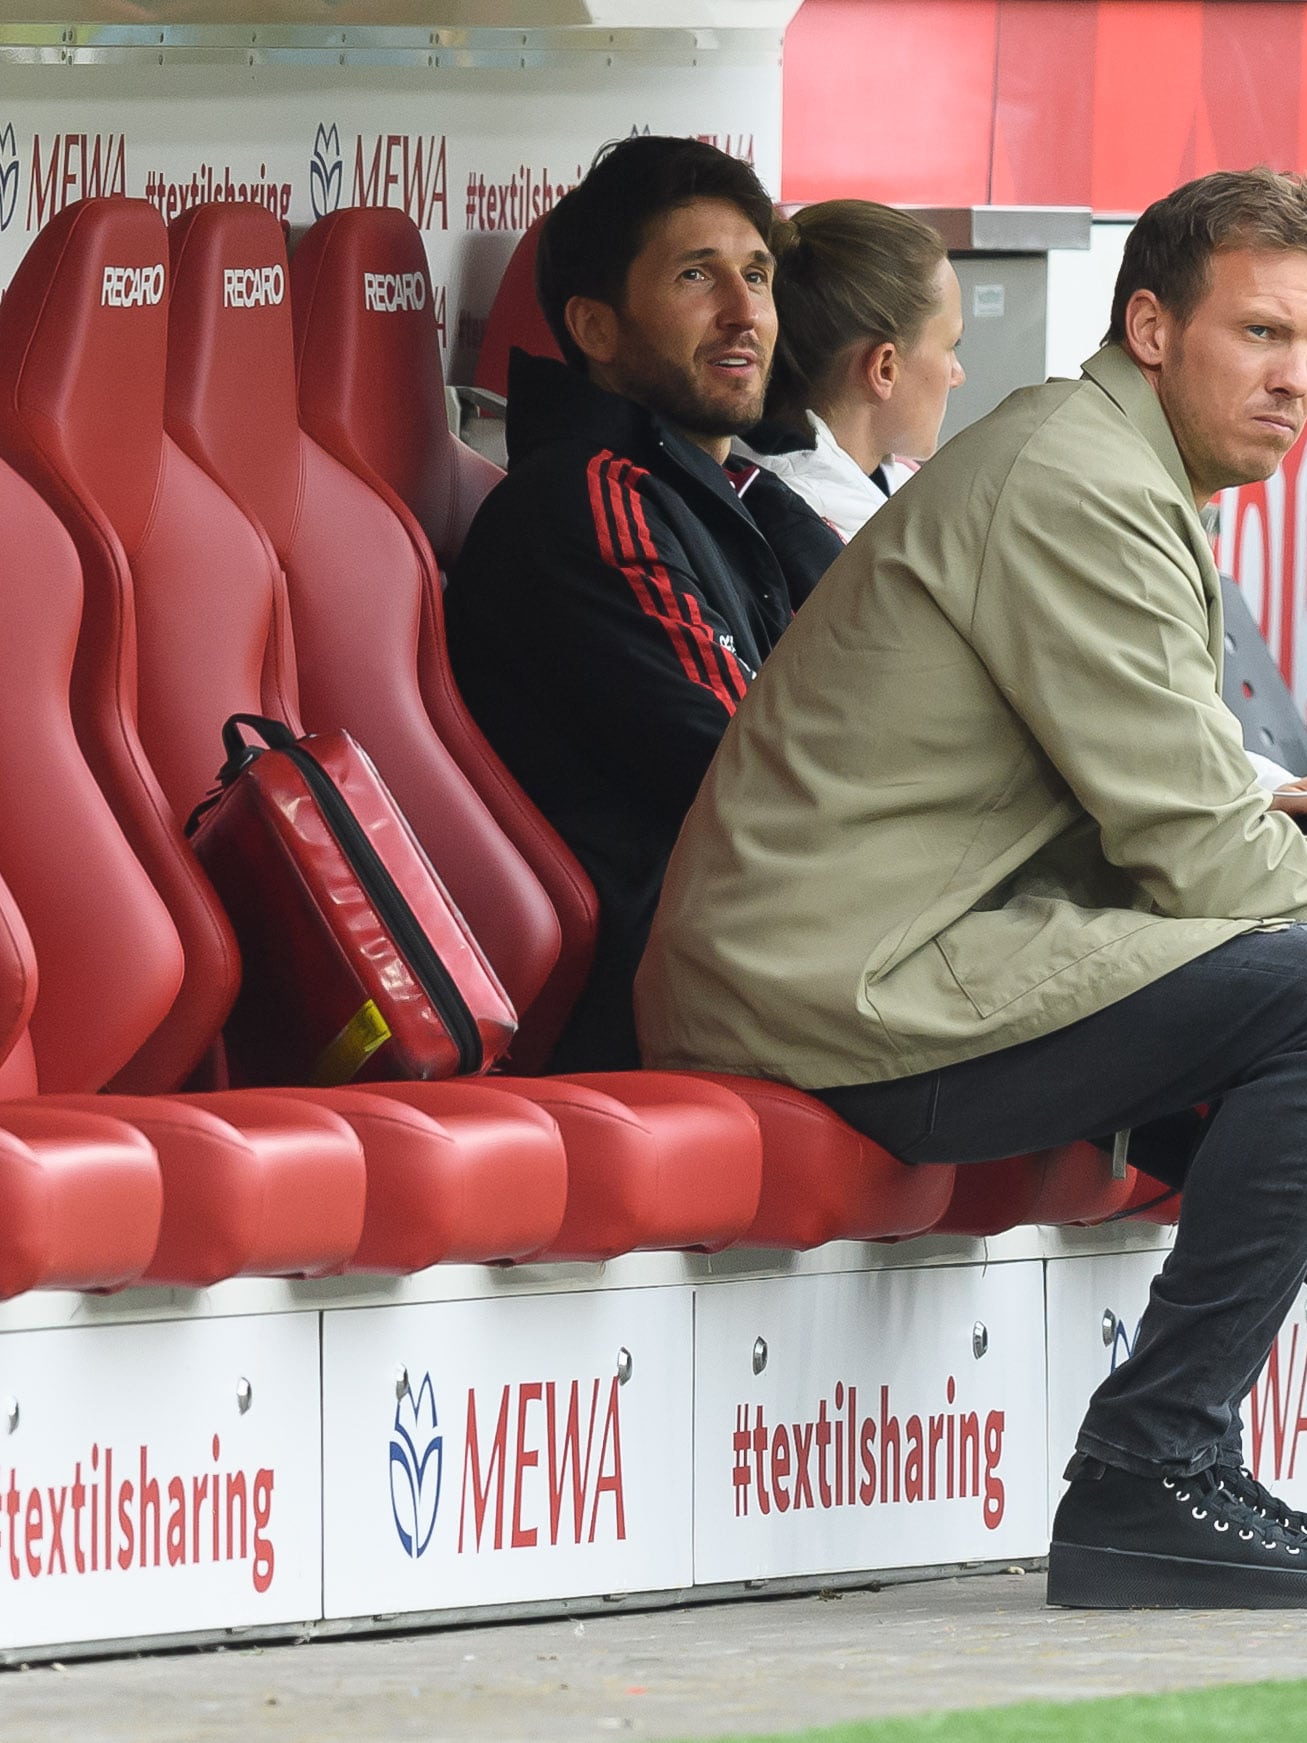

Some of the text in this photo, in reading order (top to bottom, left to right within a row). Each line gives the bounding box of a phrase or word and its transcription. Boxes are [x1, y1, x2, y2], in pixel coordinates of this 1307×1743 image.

[352, 134, 448, 230] MEWA
[101, 263, 165, 307] RECARO
[223, 263, 285, 308] RECARO
[364, 271, 426, 312] RECARO
[457, 1375, 626, 1554] MEWA
[732, 1375, 1006, 1530] #textilsharing
[0, 1432, 274, 1594] textilsharing
